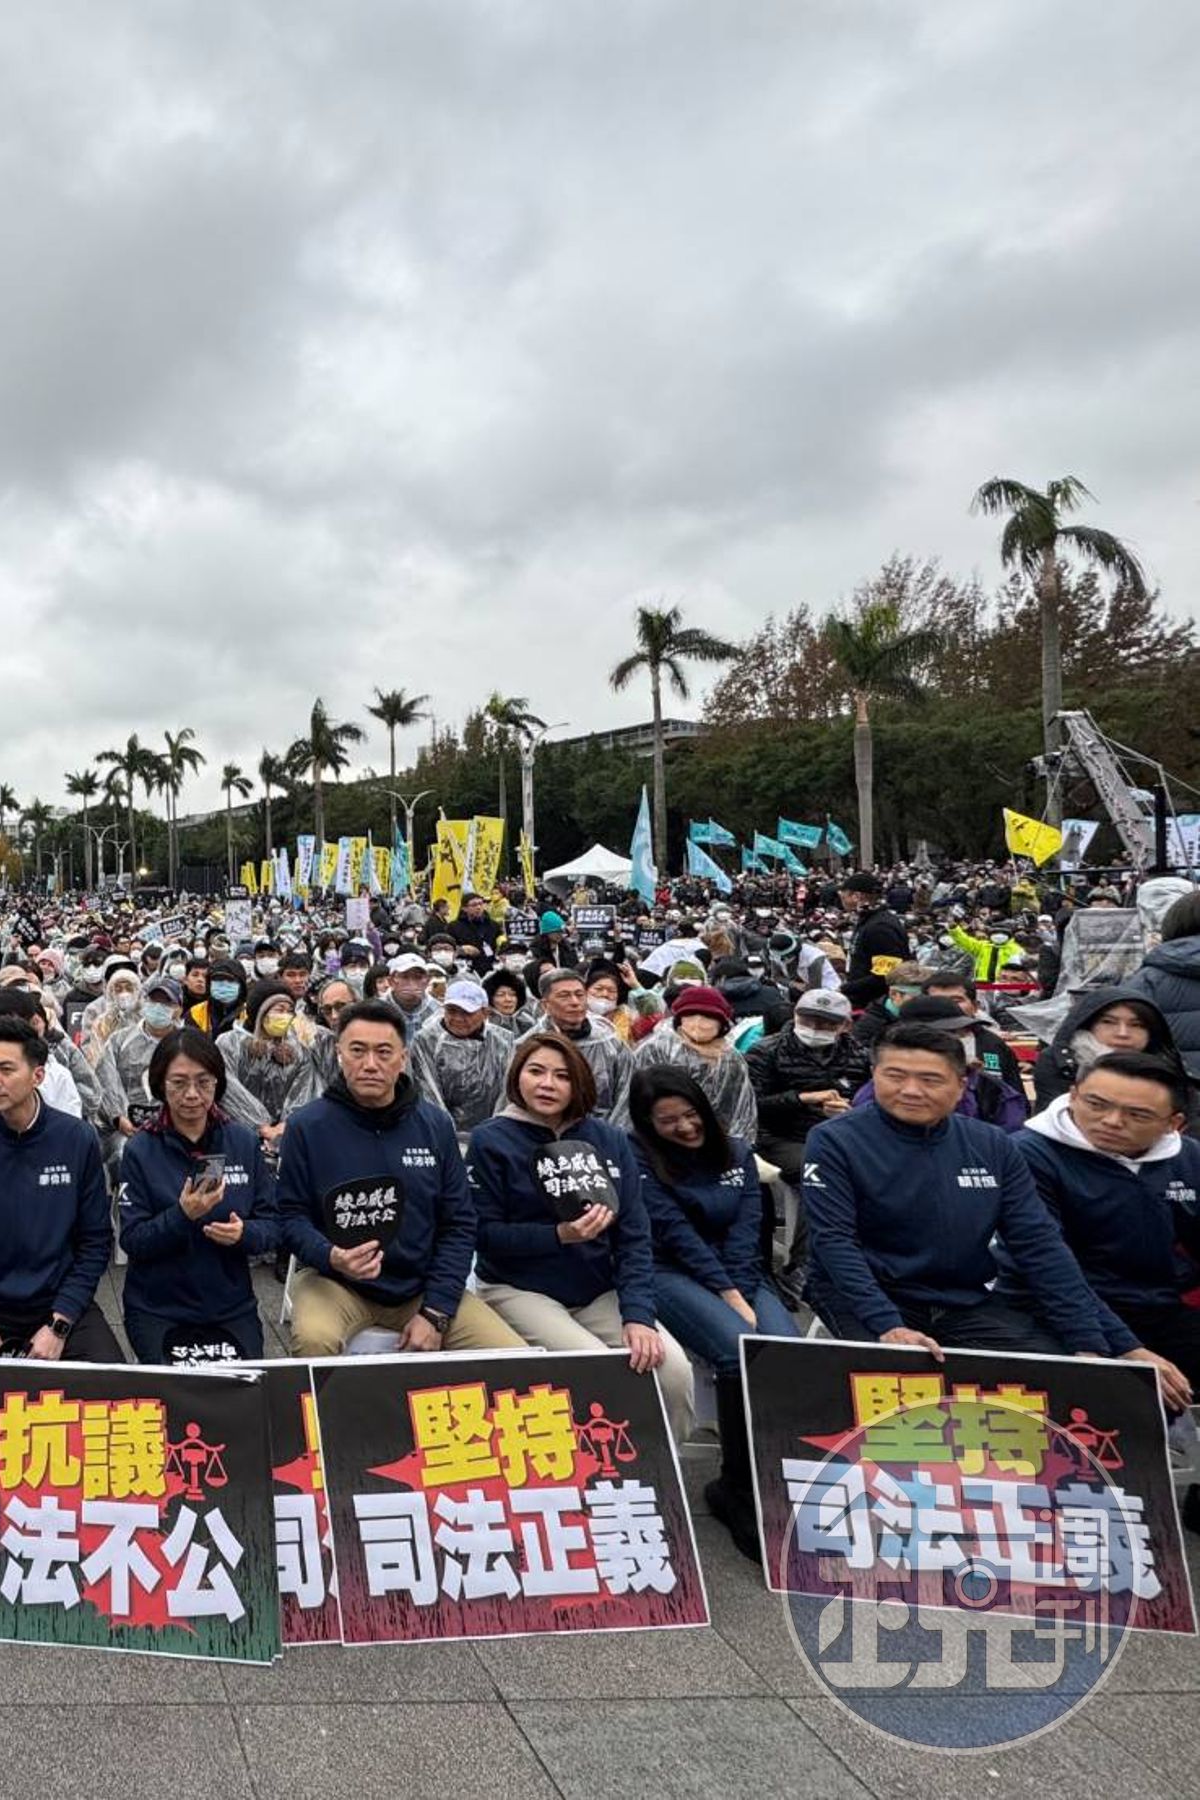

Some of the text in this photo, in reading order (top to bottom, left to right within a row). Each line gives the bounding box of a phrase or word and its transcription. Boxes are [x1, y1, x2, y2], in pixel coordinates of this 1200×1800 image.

[336, 1207, 396, 1230] 司法不公
[544, 1174, 608, 1198] 司法不公
[410, 1382, 578, 1487] 堅持
[852, 1374, 1051, 1476] 堅持
[274, 1494, 338, 1609] 司
[353, 1479, 677, 1606] 司法正義
[782, 1458, 1163, 1600] 司法正義
